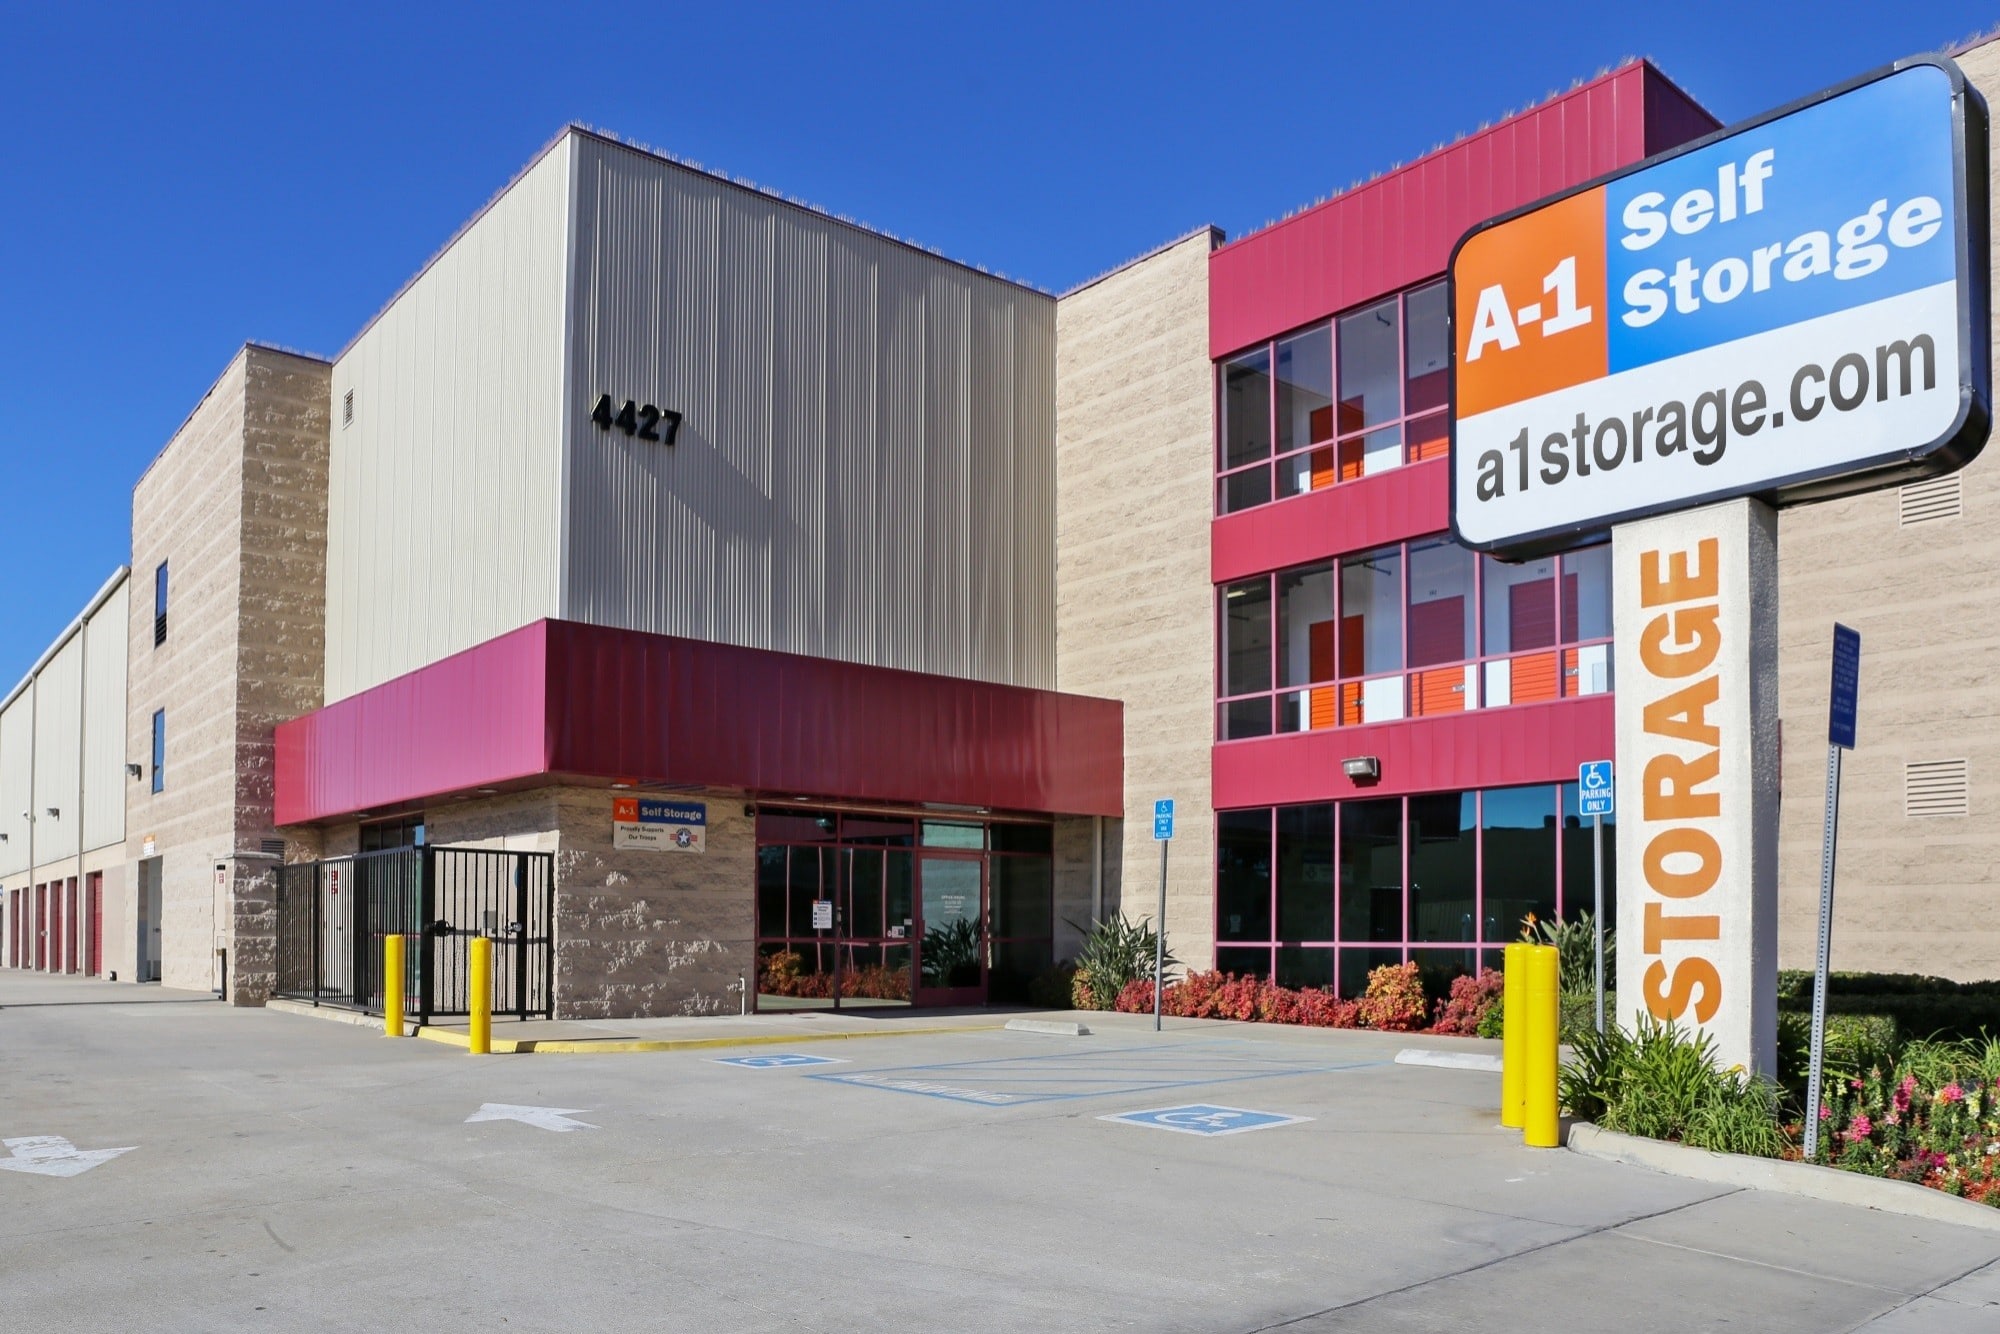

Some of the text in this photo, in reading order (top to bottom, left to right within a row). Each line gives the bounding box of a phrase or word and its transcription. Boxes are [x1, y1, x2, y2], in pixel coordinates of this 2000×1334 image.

[1620, 148, 1774, 251] Self
[1621, 196, 1942, 329] Storage
[1465, 256, 1592, 363] A-1
[591, 394, 682, 446] 4427
[1476, 333, 1936, 503] a1storage.com
[619, 805, 702, 821] A-1 Self Storage
[1581, 788, 1611, 800] PARKING
[1587, 800, 1606, 811] ONLY
[1639, 537, 1722, 1026] STORAGE
[620, 825, 641, 833] Proudly
